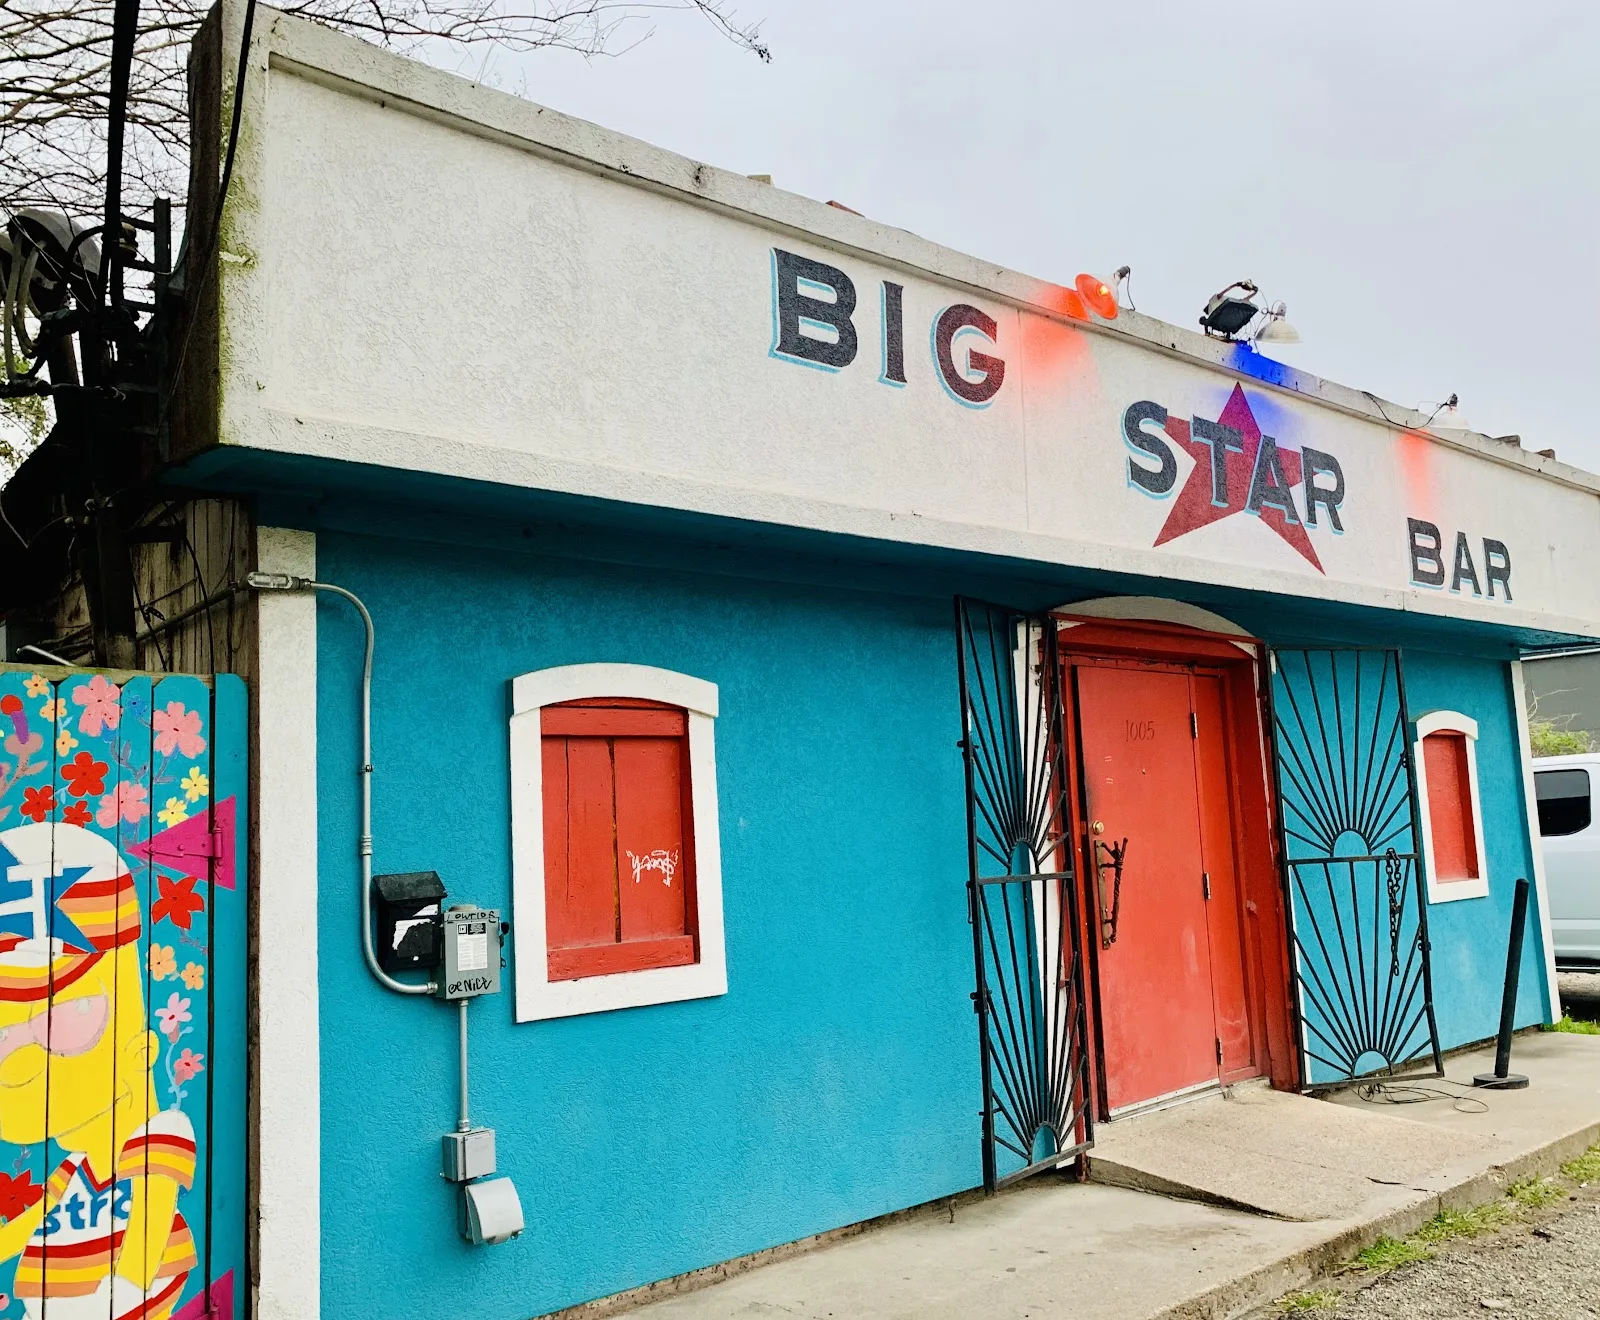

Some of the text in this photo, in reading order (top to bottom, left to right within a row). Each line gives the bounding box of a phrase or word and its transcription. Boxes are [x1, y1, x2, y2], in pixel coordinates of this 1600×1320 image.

[768, 247, 1006, 411] BIG
[1120, 400, 1345, 536] STAR
[1406, 517, 1513, 604] BAR
[1125, 719, 1155, 742] 1005
